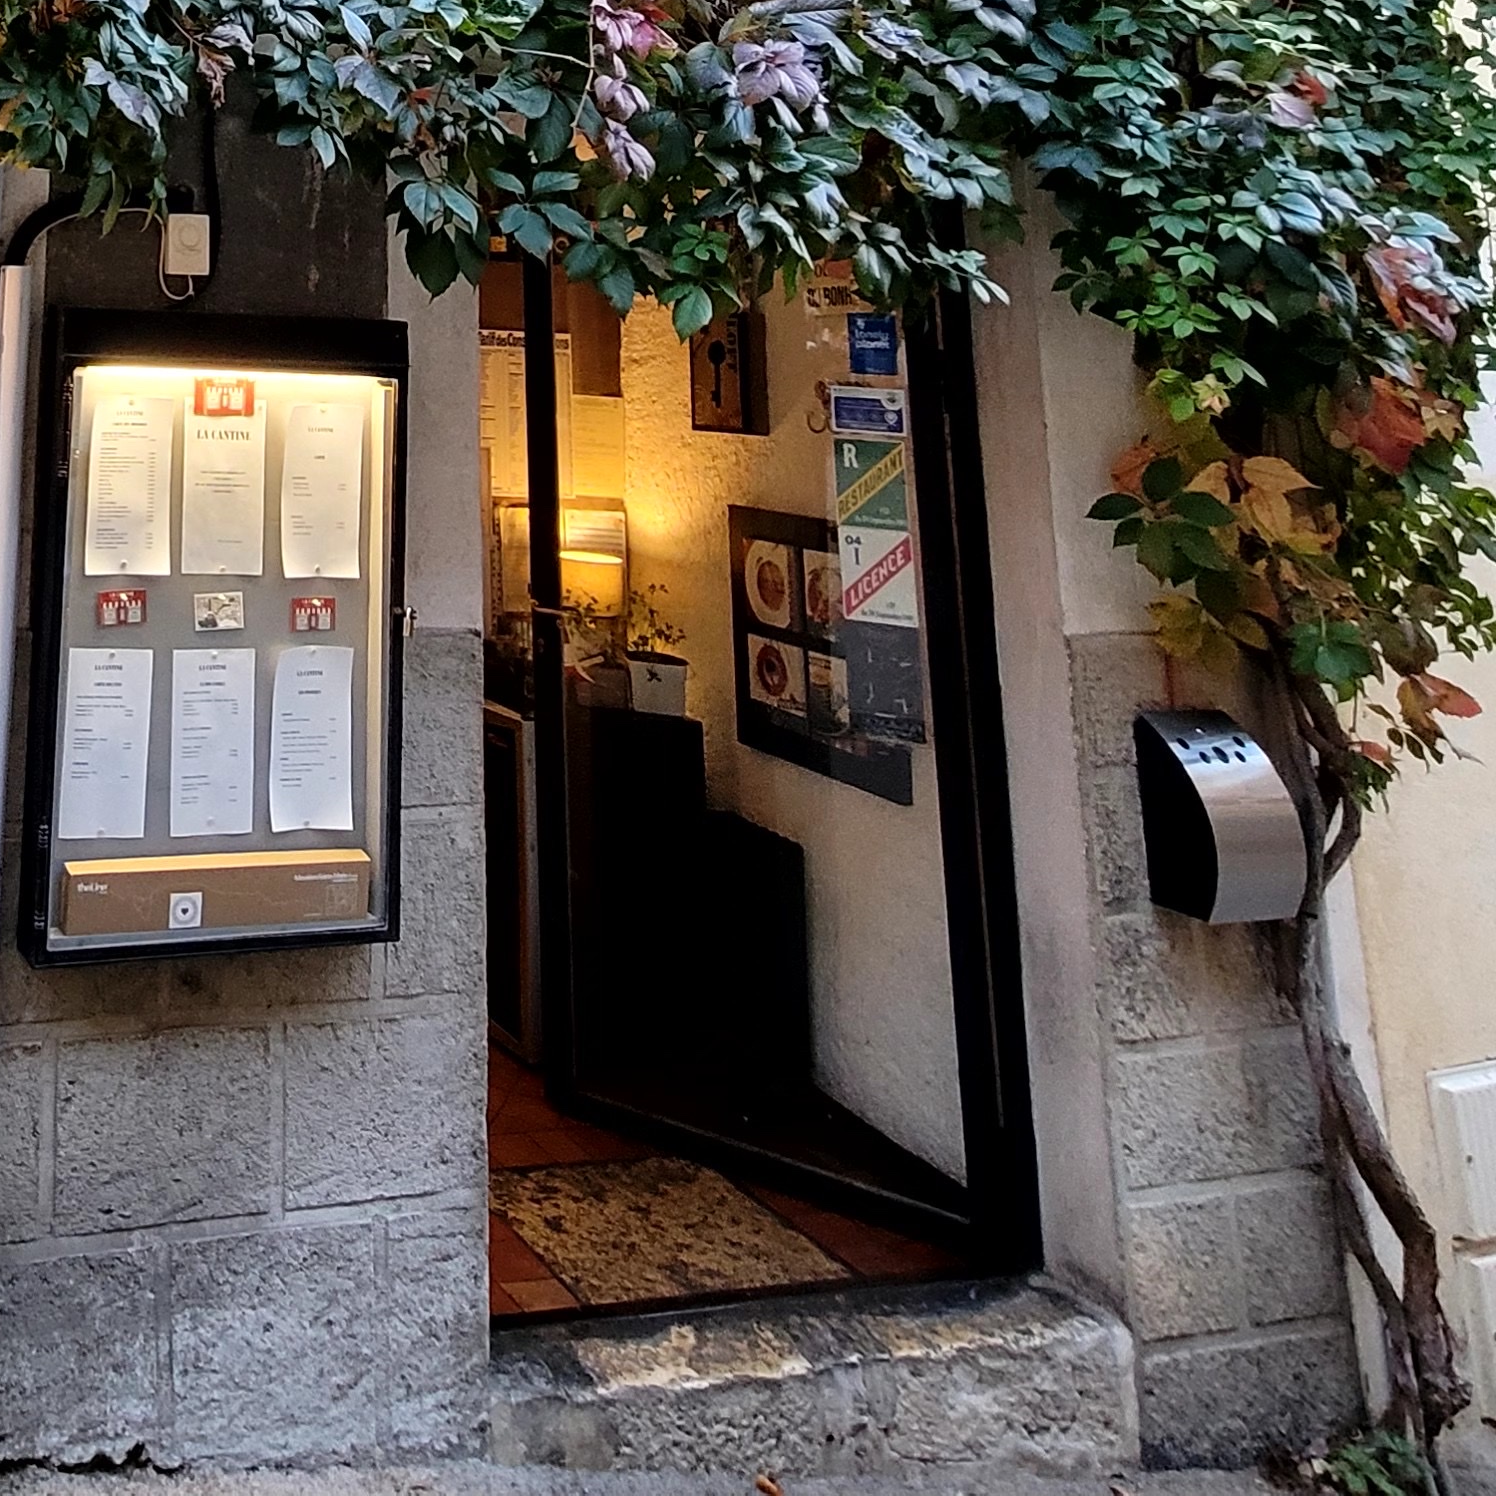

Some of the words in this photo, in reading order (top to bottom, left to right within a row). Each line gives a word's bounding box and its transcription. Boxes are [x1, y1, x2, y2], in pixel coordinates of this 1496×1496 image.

[197, 429, 209, 440] LA
[211, 430, 252, 441] CANTINE
[842, 443, 859, 468] R
[838, 448, 905, 518] RESTAURANT
[845, 535, 862, 546] 04
[849, 545, 906, 607] LICENCE
